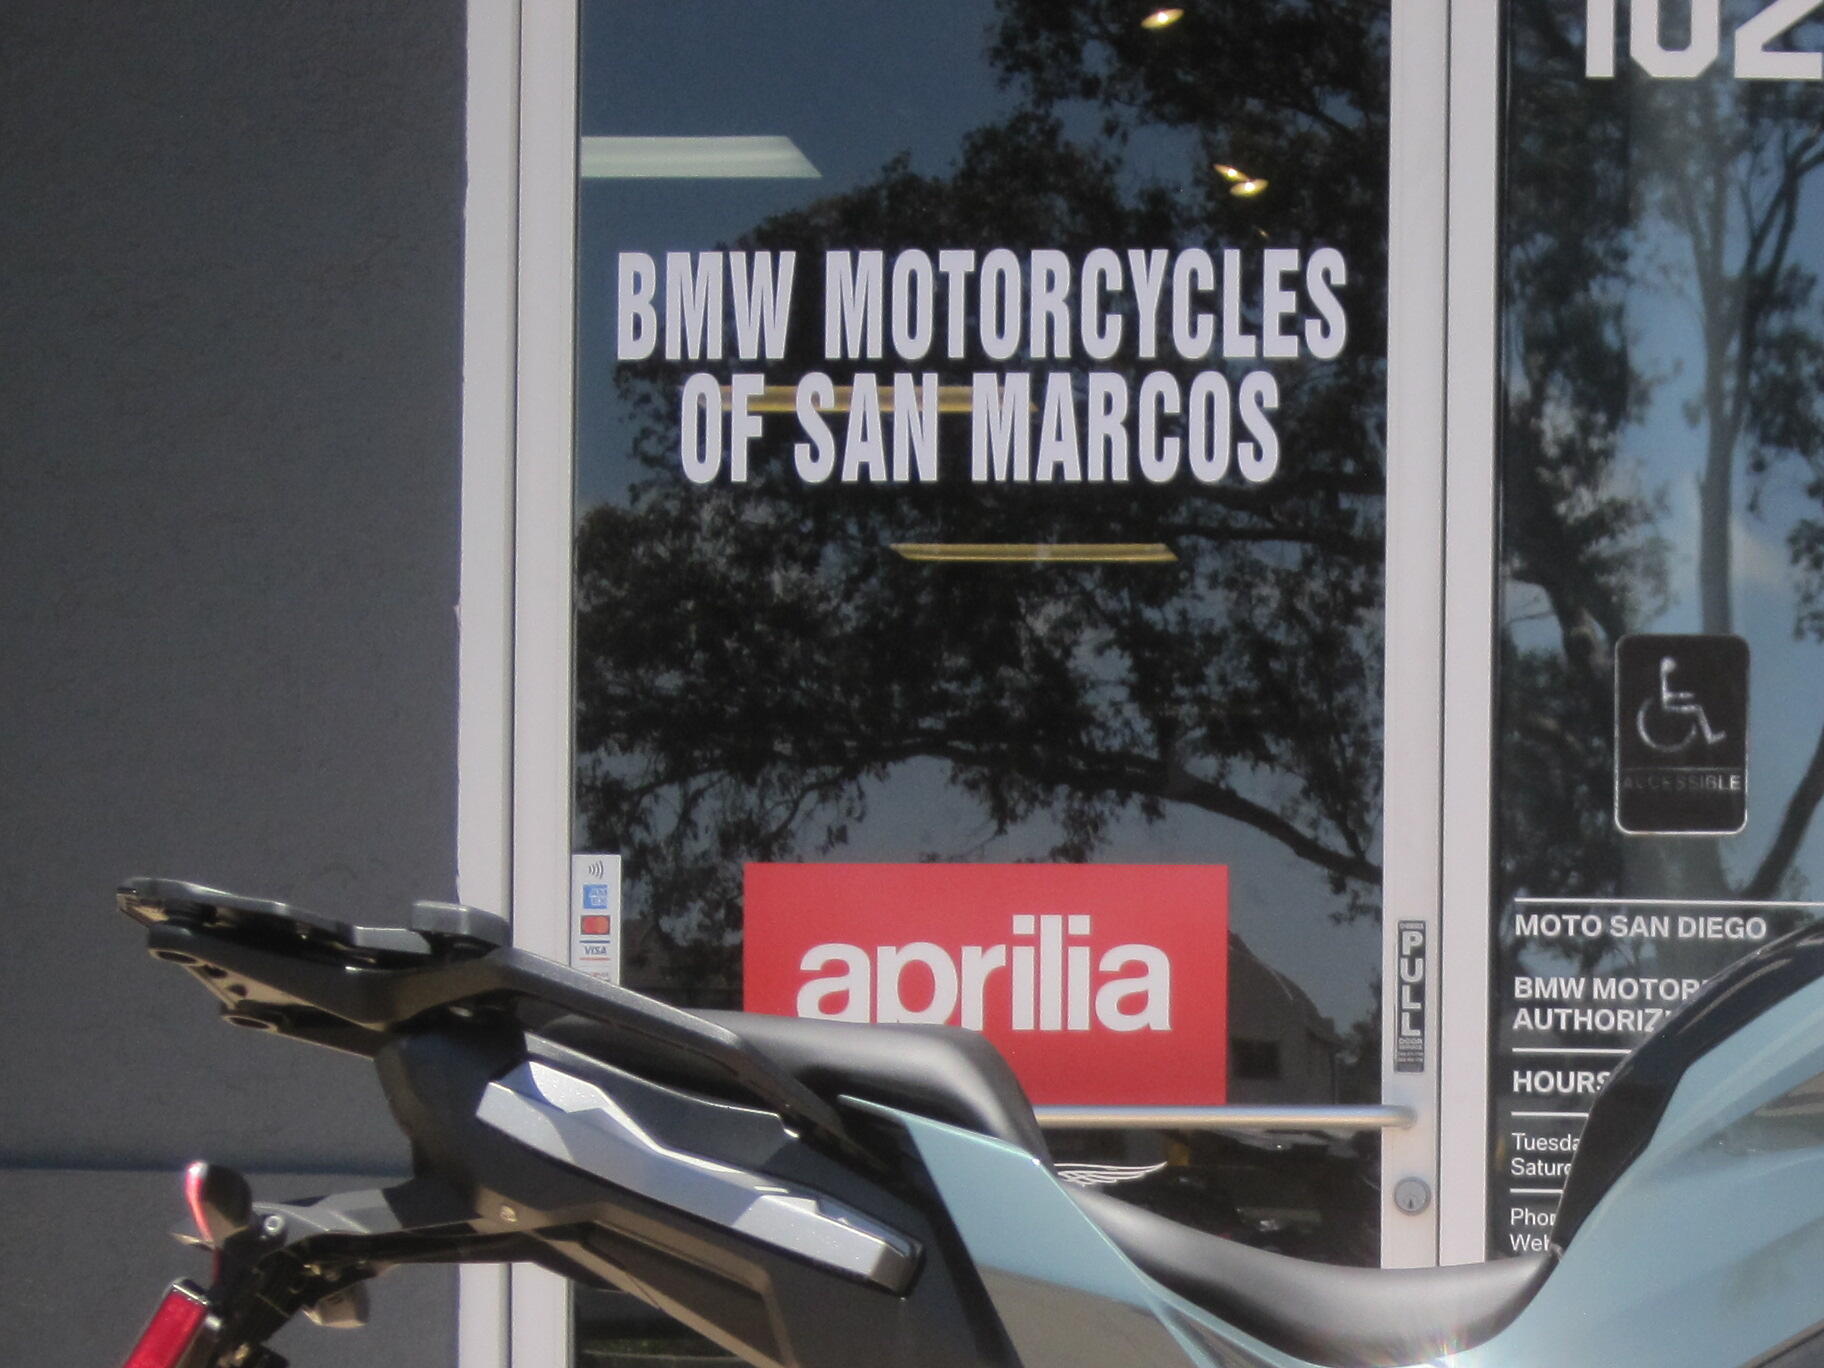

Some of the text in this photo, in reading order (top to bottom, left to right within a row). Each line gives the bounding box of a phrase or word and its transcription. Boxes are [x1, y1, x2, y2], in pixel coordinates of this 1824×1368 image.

[616, 247, 1348, 361] BMW MOTORCYCLES
[680, 370, 1280, 484] OF SAN MARCOS
[796, 914, 1172, 1032] aprilia
[1514, 913, 1768, 940] MOTO SAN DIEGO
[1400, 930, 1424, 1037] PULL
[1512, 1007, 1672, 1033] AUTHORIZ
[1513, 976, 1586, 999] BMW
